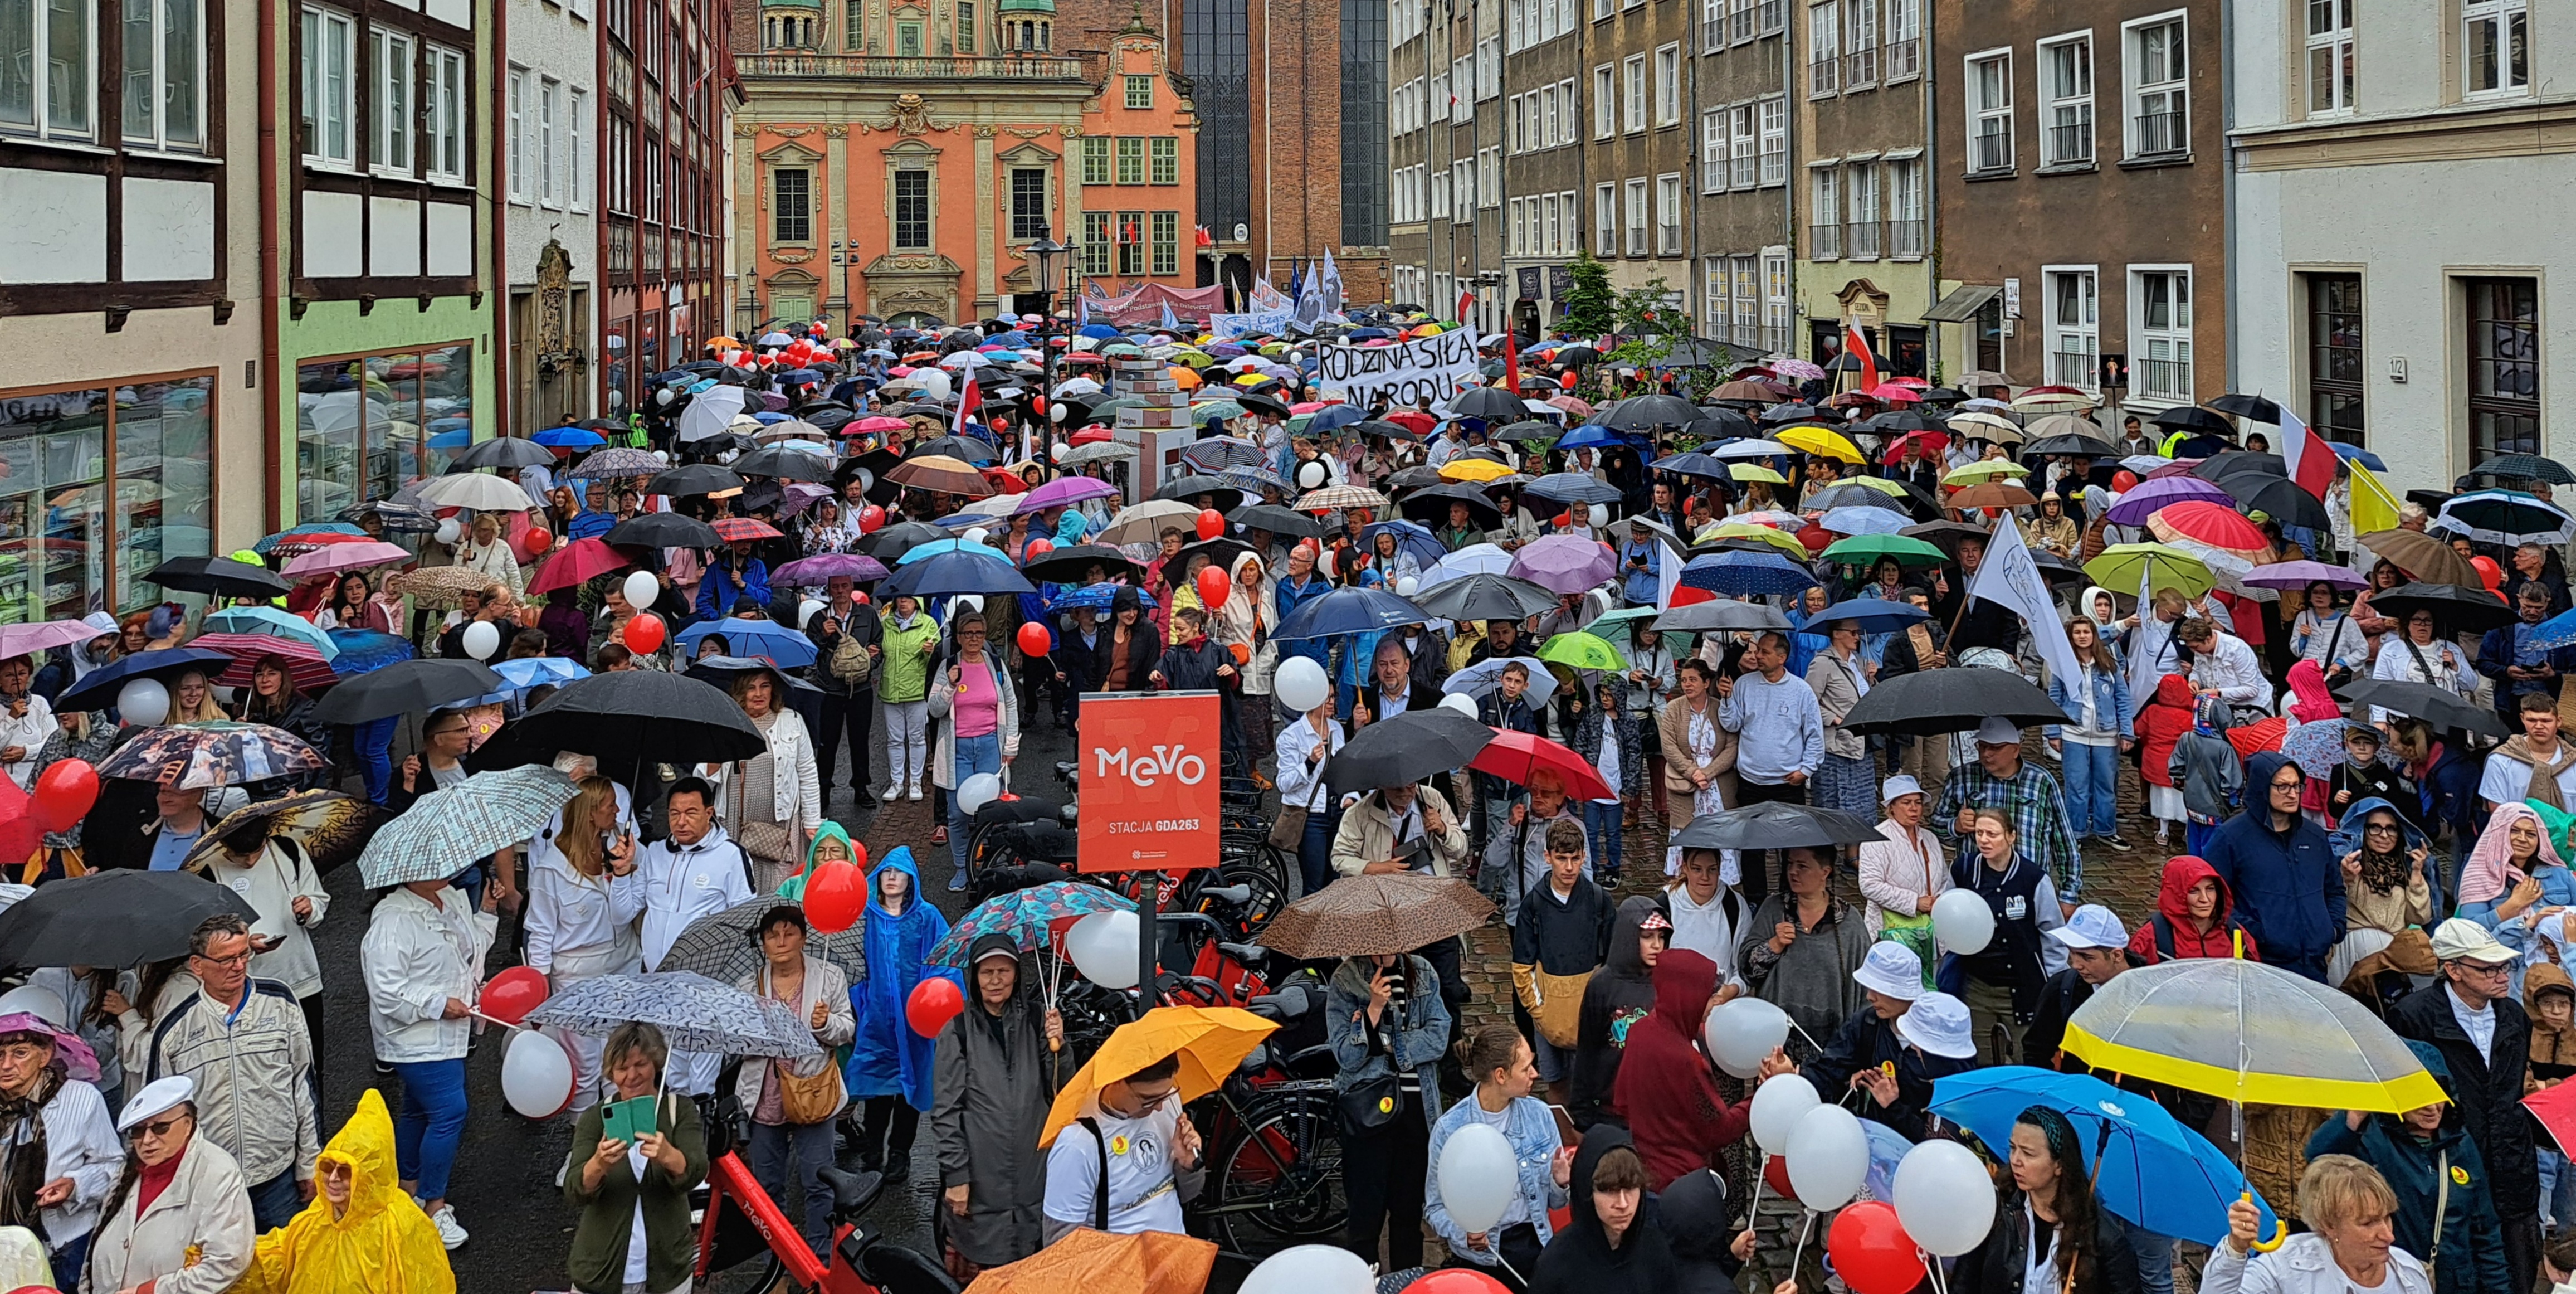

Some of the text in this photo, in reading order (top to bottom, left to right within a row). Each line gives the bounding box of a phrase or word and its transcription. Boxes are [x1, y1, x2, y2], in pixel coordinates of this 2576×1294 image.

[1257, 314, 1286, 325] Czas
[1320, 333, 1475, 381] RODZINA SIŁA
[1348, 372, 1453, 412] NARODU
[1109, 819, 1199, 834] STACJA GDA263
